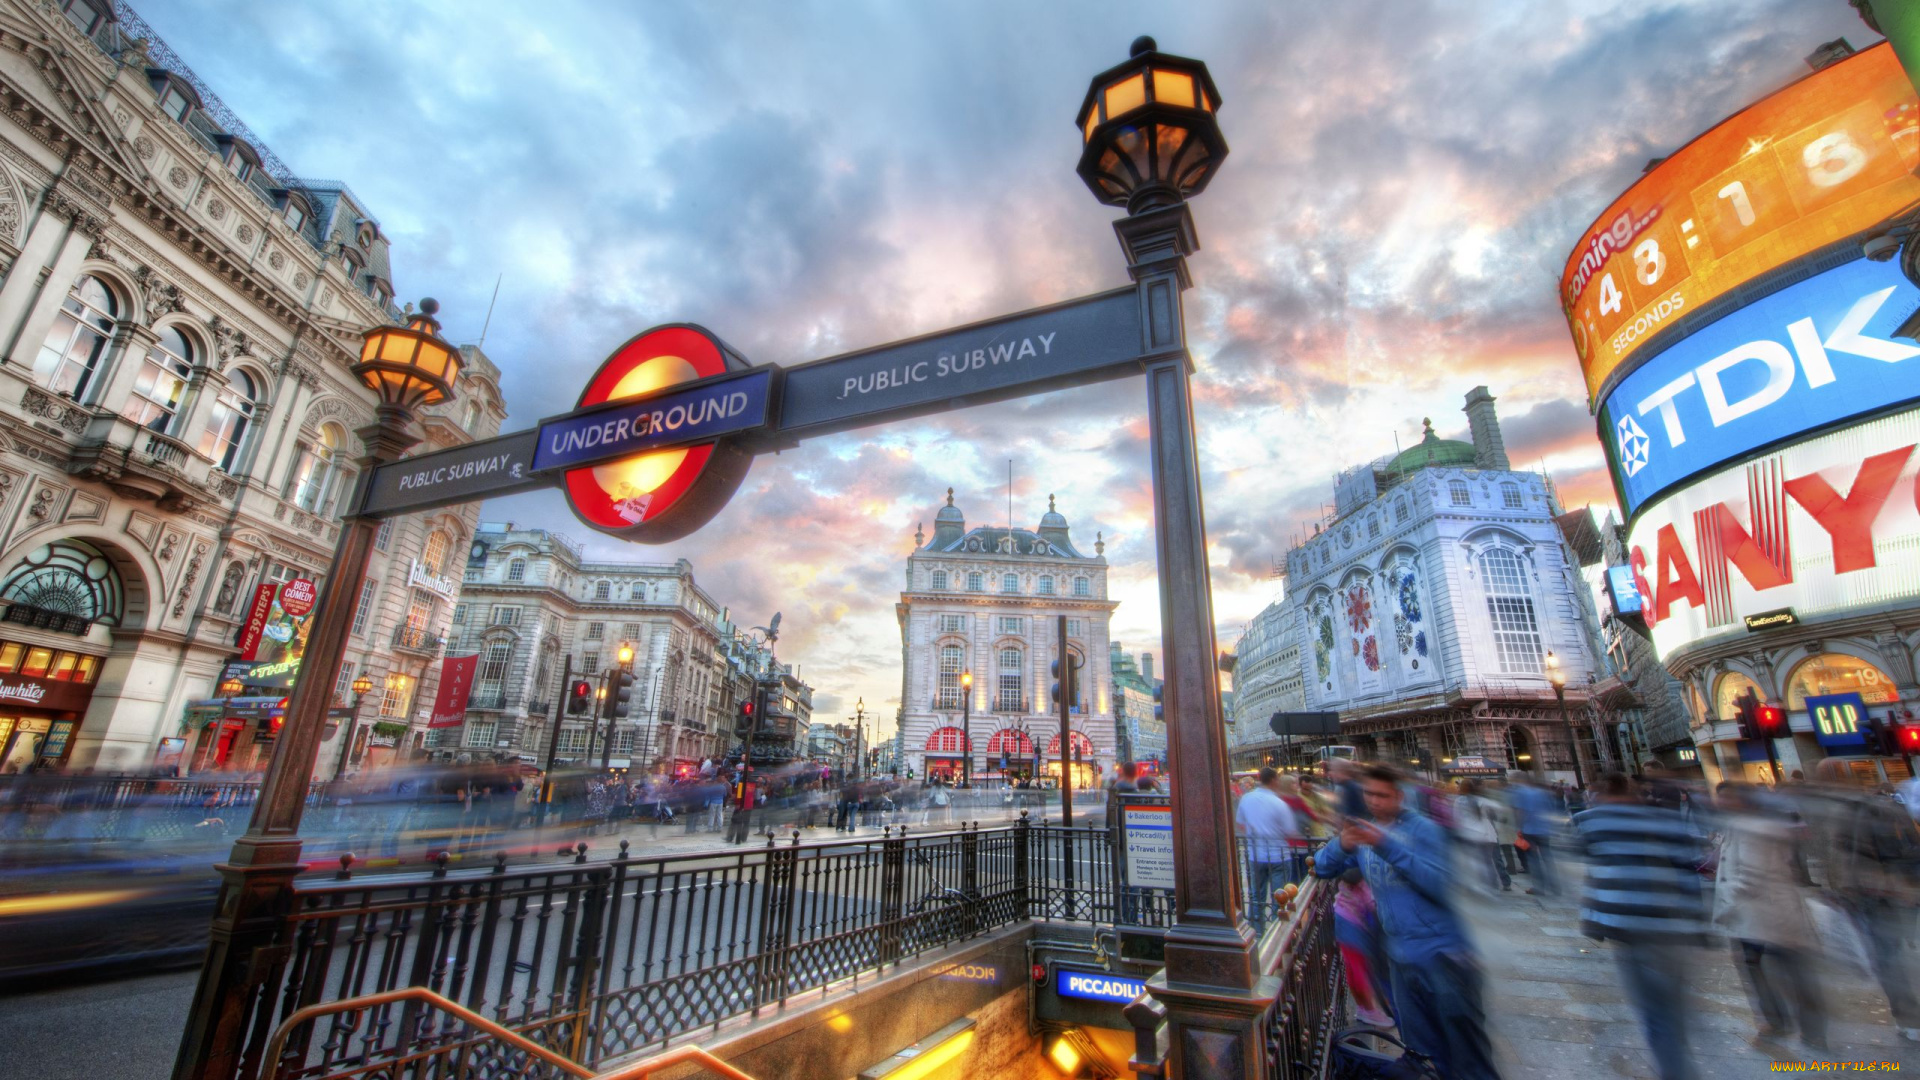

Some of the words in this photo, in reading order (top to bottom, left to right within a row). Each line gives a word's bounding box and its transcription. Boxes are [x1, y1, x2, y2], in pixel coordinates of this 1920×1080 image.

[1612, 292, 1685, 355] SECONDS
[842, 361, 928, 398] PUBLIC
[936, 332, 1057, 377] SUBWAY
[1637, 285, 1920, 448] TDK
[552, 391, 748, 455] UNDERGROUND
[399, 466, 446, 491] PUBLIC
[447, 453, 511, 482] SUBWAY
[1630, 443, 1920, 630] SANY
[294, 581, 312, 592] BEST
[408, 557, 454, 602] Lillywhites
[285, 588, 314, 603] COMEDY
[249, 618, 262, 634] 39
[450, 663, 463, 708] SALE
[52, 722, 73, 733] THIS
[1815, 703, 1859, 735] GAP
[45, 743, 65, 754] ONL
[1679, 749, 1696, 761] GAP
[1134, 812, 1163, 821] Bakerloo
[1135, 831, 1166, 841] Piccadilly
[1135, 845, 1156, 853] Travel
